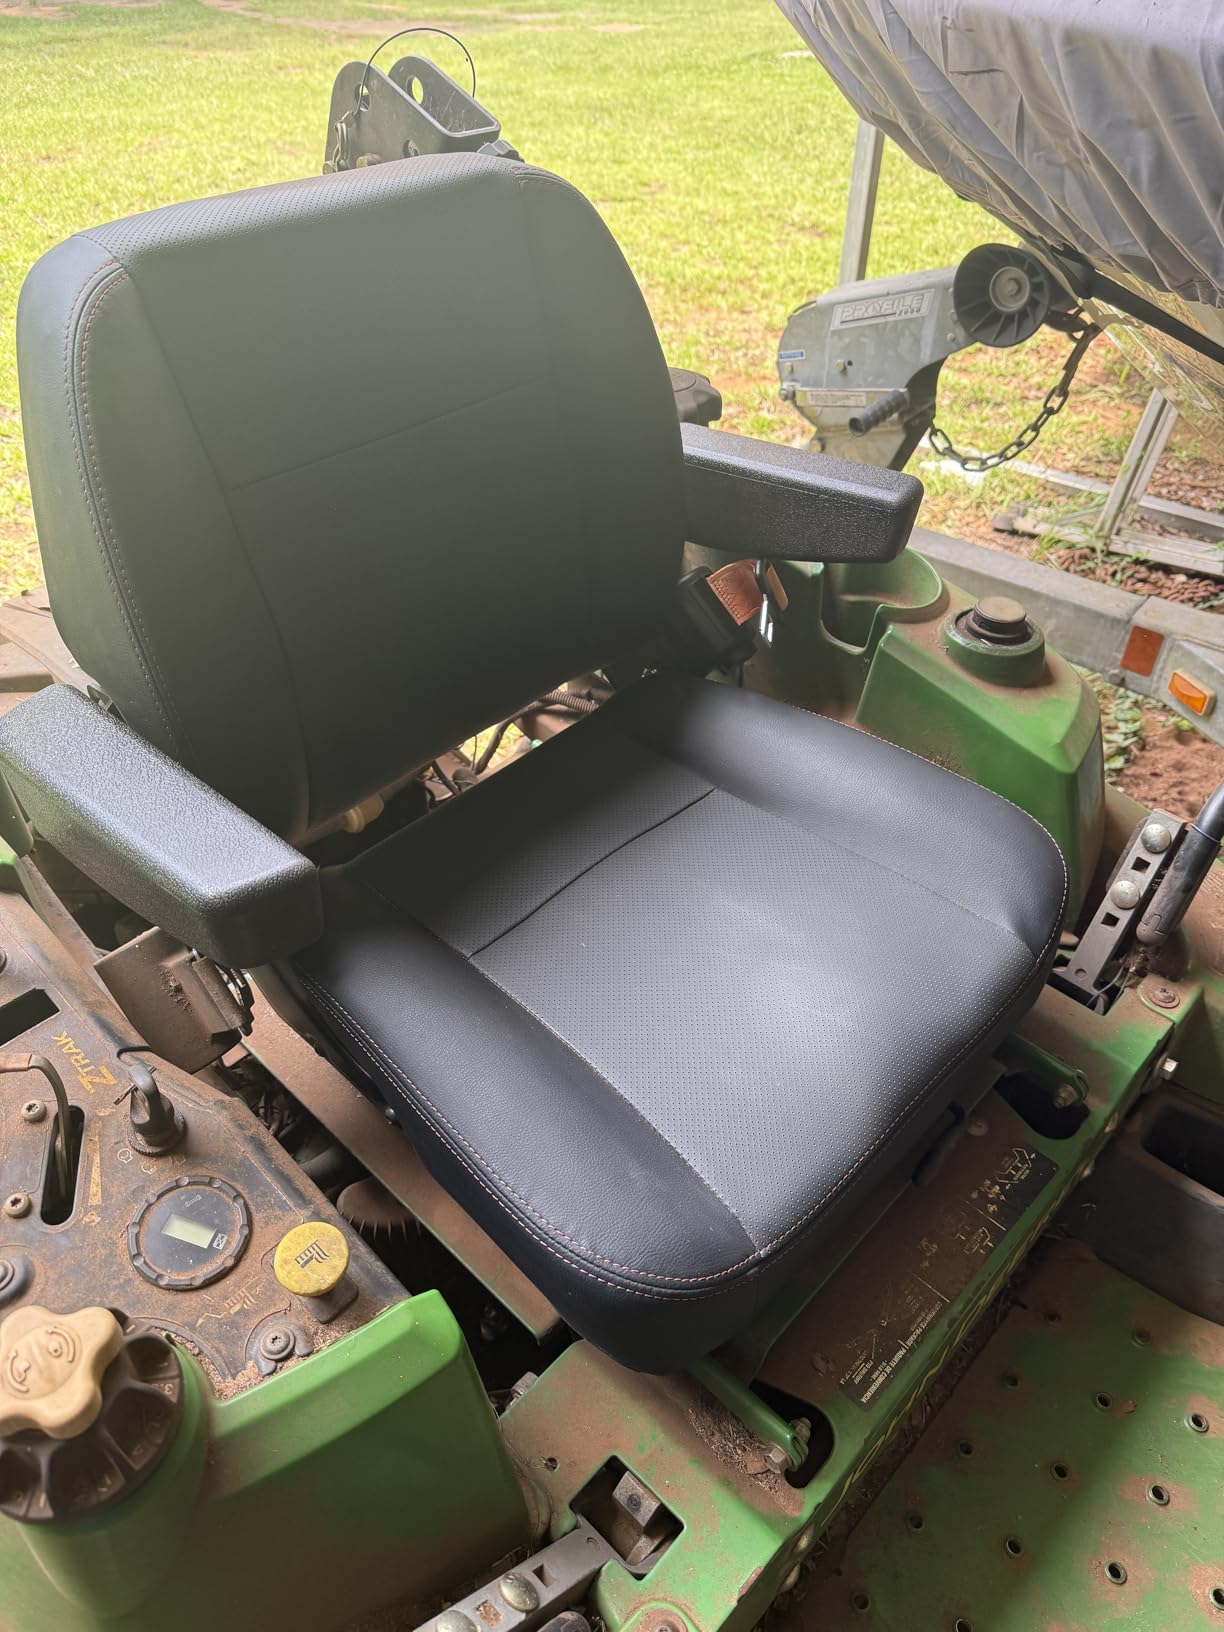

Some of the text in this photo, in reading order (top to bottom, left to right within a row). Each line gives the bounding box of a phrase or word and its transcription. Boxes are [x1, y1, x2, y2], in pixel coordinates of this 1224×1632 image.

[842, 294, 923, 319] PROFILE
[860, 1346, 906, 1403] PAQUETE DE CONVENIENCIA
